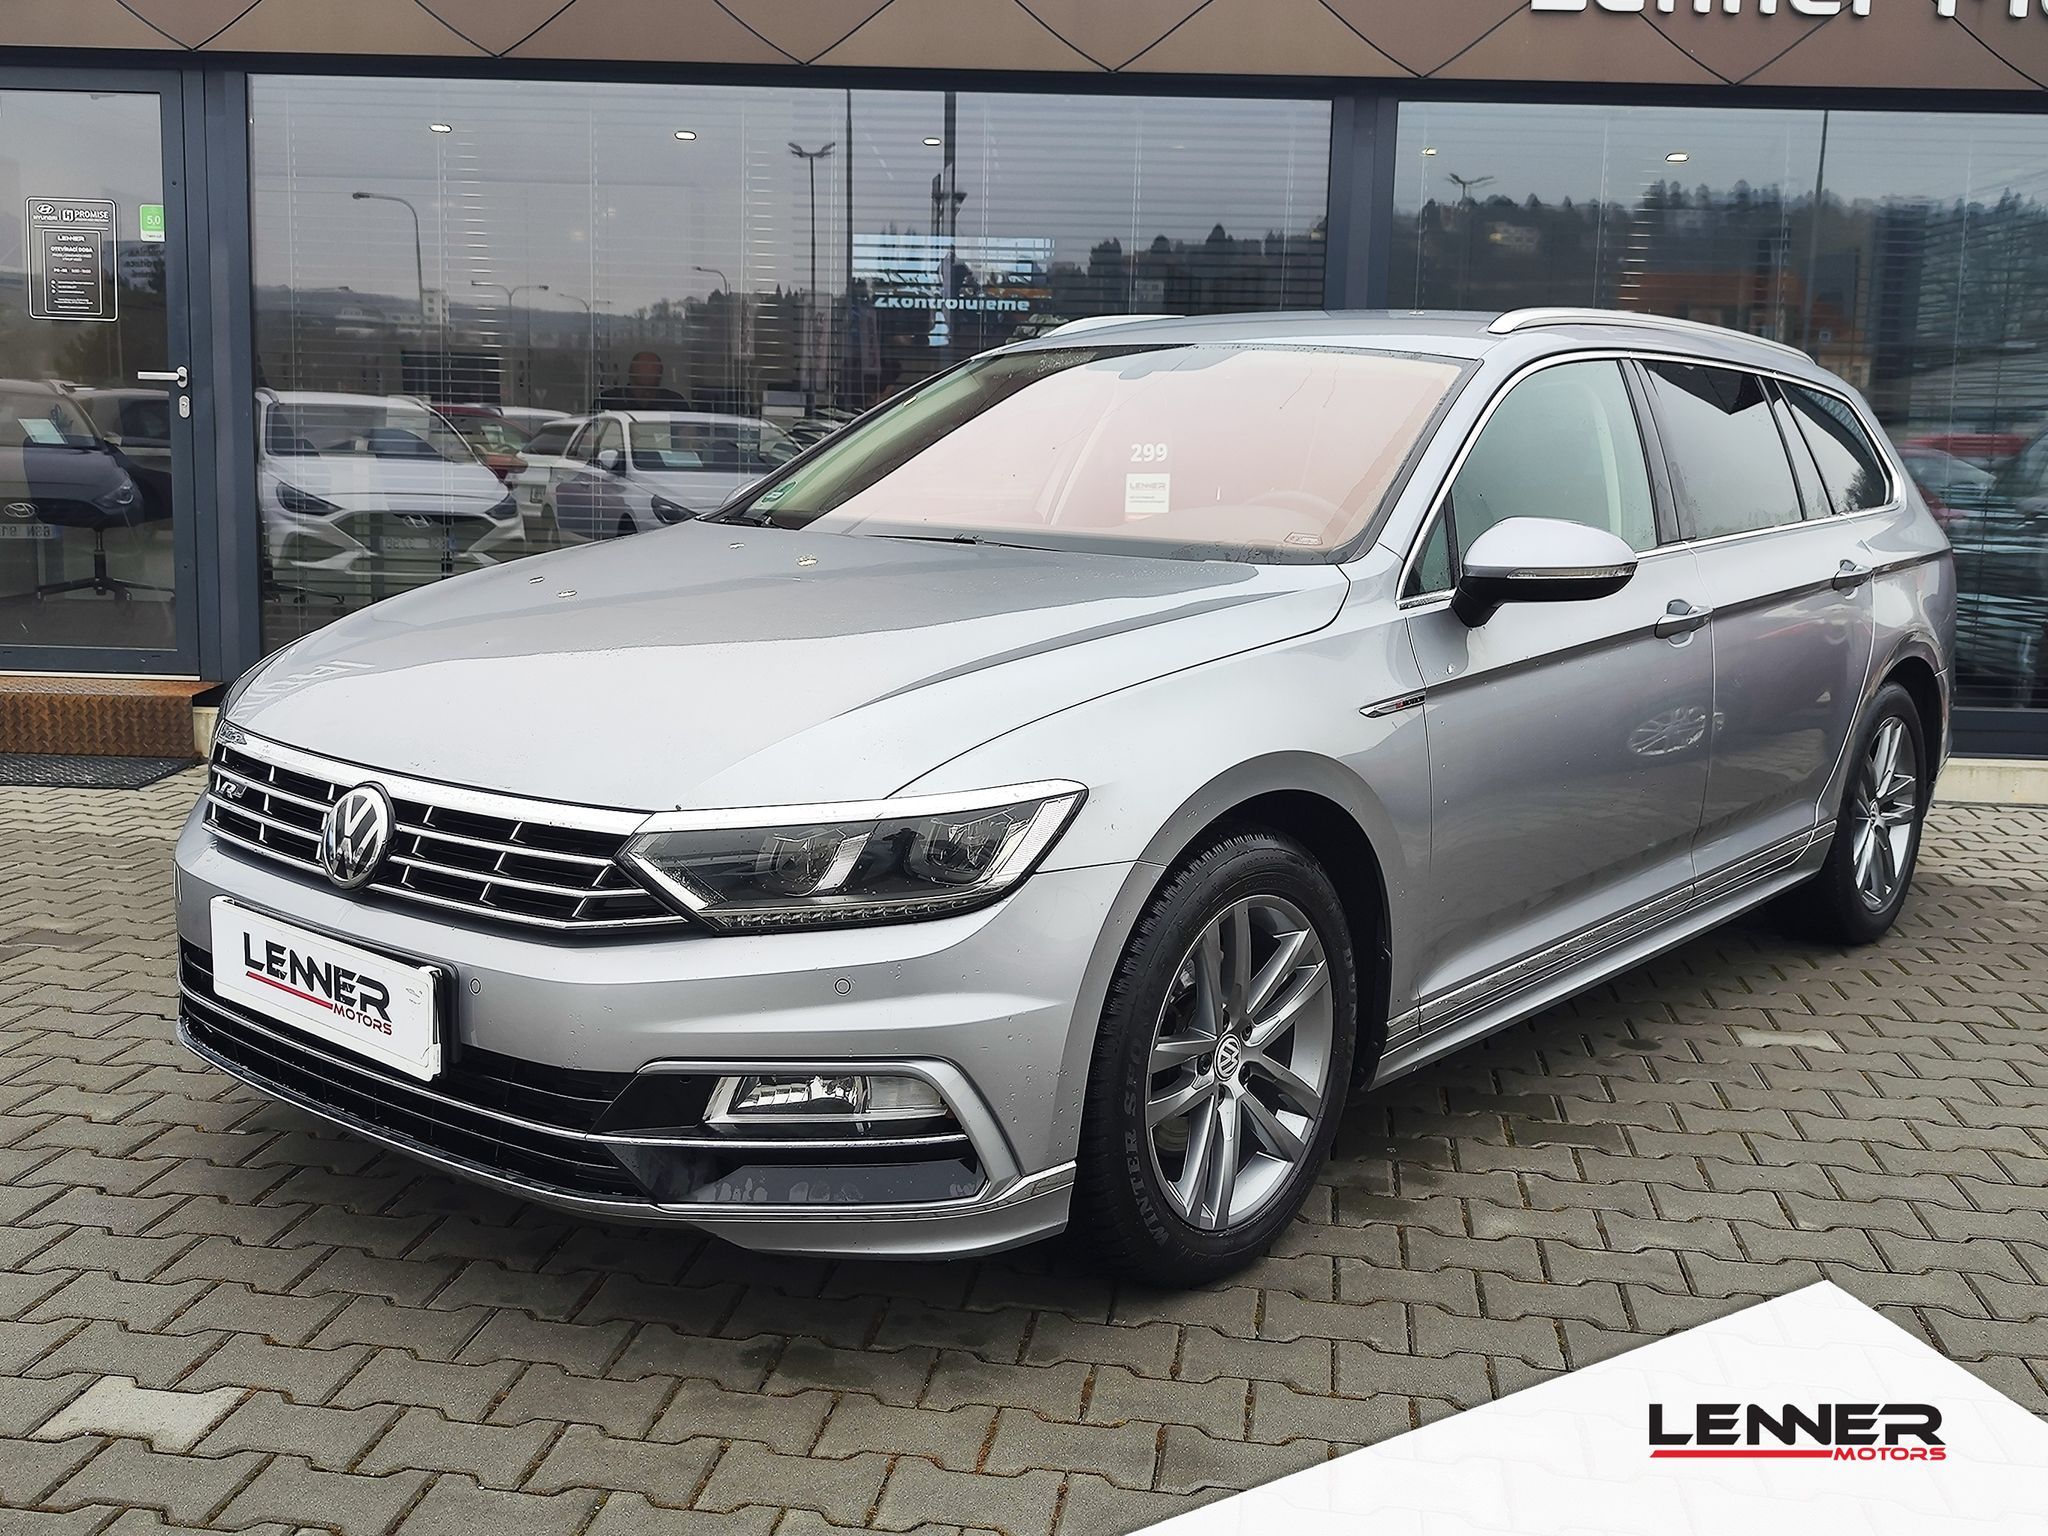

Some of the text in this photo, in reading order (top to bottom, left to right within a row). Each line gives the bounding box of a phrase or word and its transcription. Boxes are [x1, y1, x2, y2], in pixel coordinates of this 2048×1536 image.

[74, 210, 109, 219] PROMISE
[146, 215, 161, 225] 5.0
[1130, 443, 1168, 462] 299
[242, 931, 392, 1023] LENNER
[333, 1003, 392, 1036] MOTORS
[1124, 1129, 1170, 1246] WINTER
